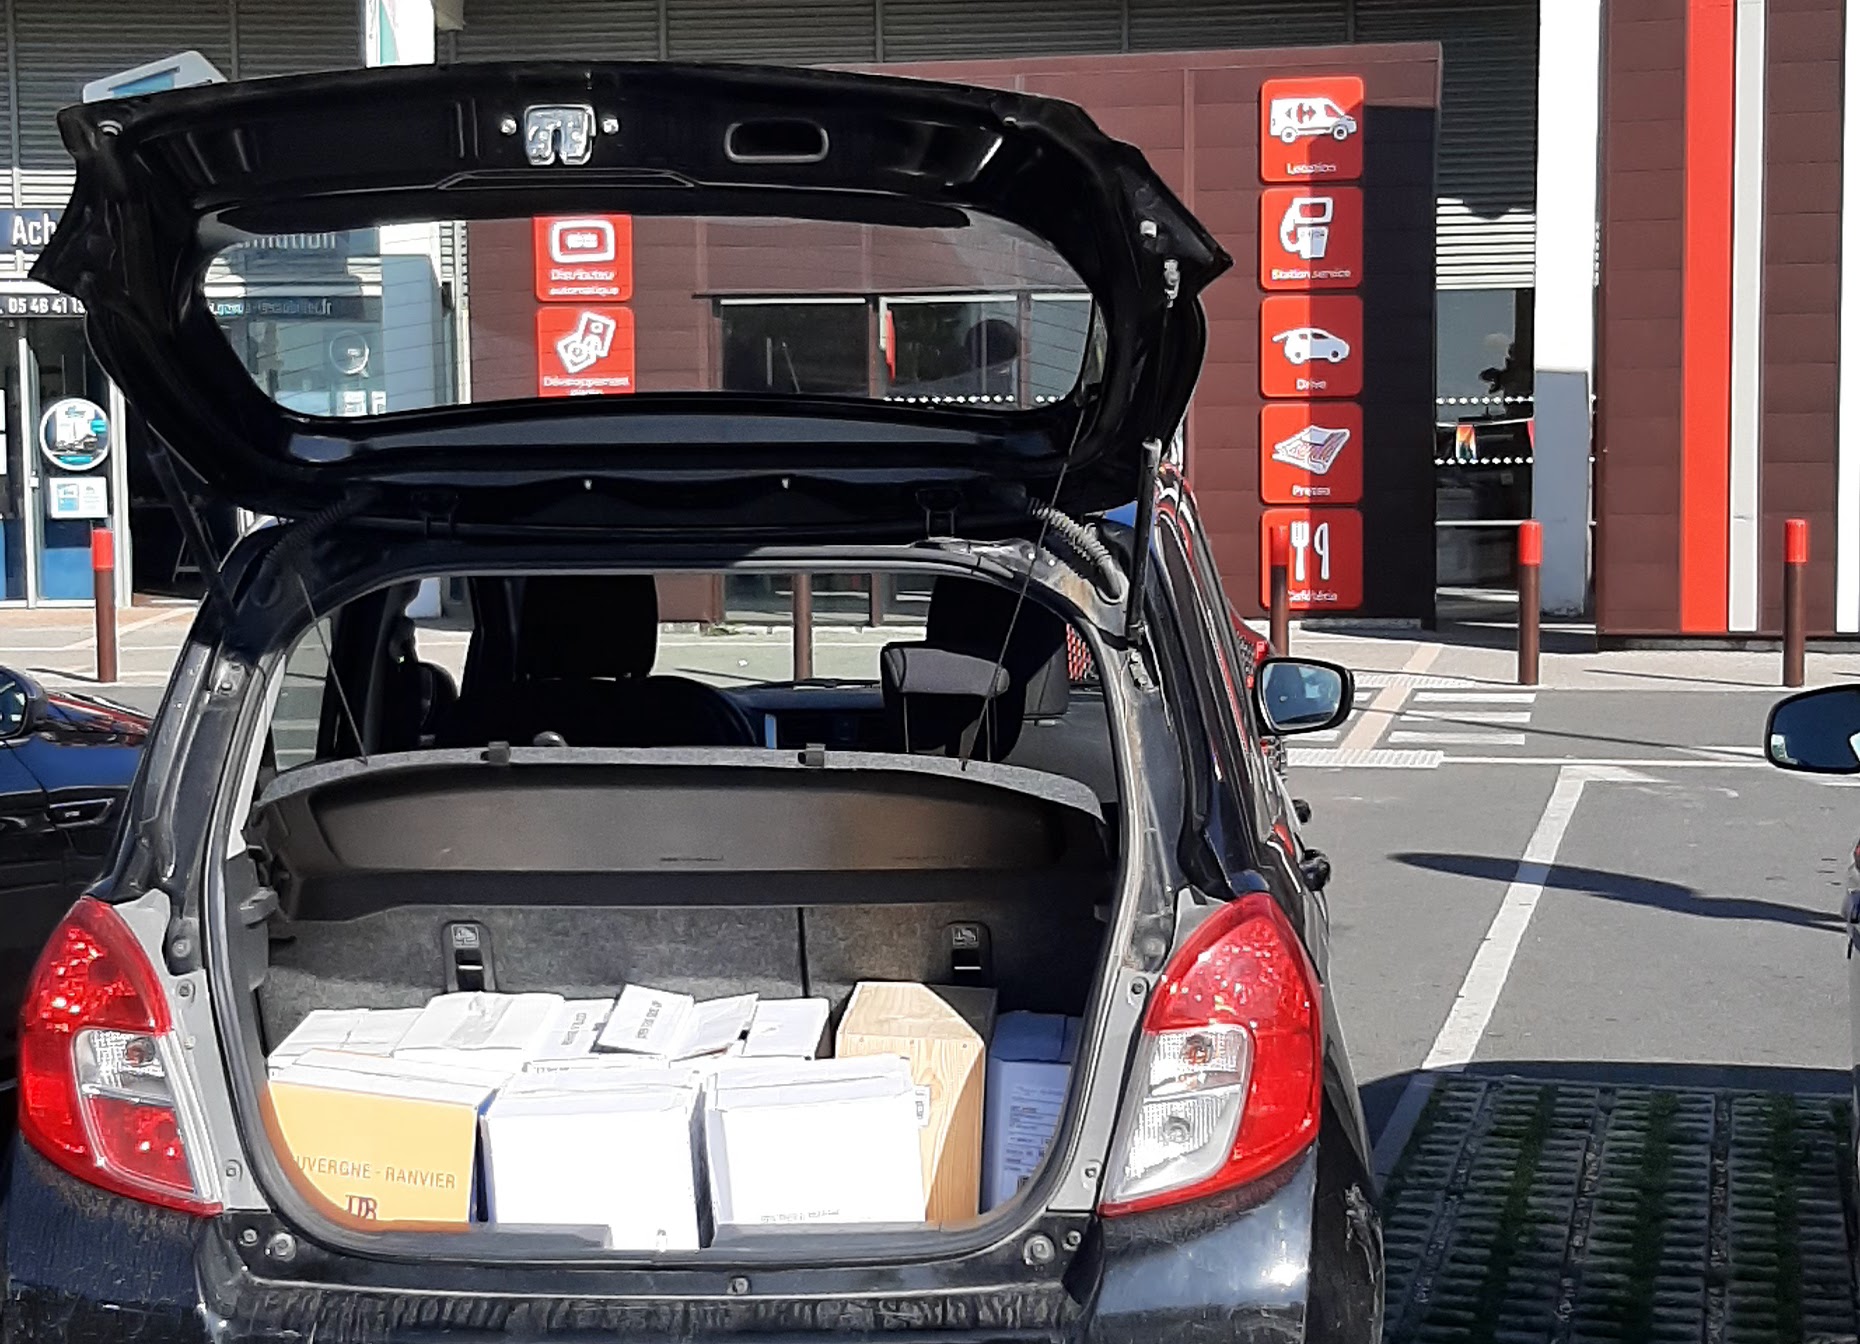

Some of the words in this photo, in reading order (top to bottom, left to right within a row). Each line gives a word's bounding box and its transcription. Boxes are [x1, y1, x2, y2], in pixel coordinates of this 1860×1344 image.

[8, 297, 27, 314] 05
[1295, 377, 1327, 391] Drive
[385, 1166, 455, 1189] RANVIER
